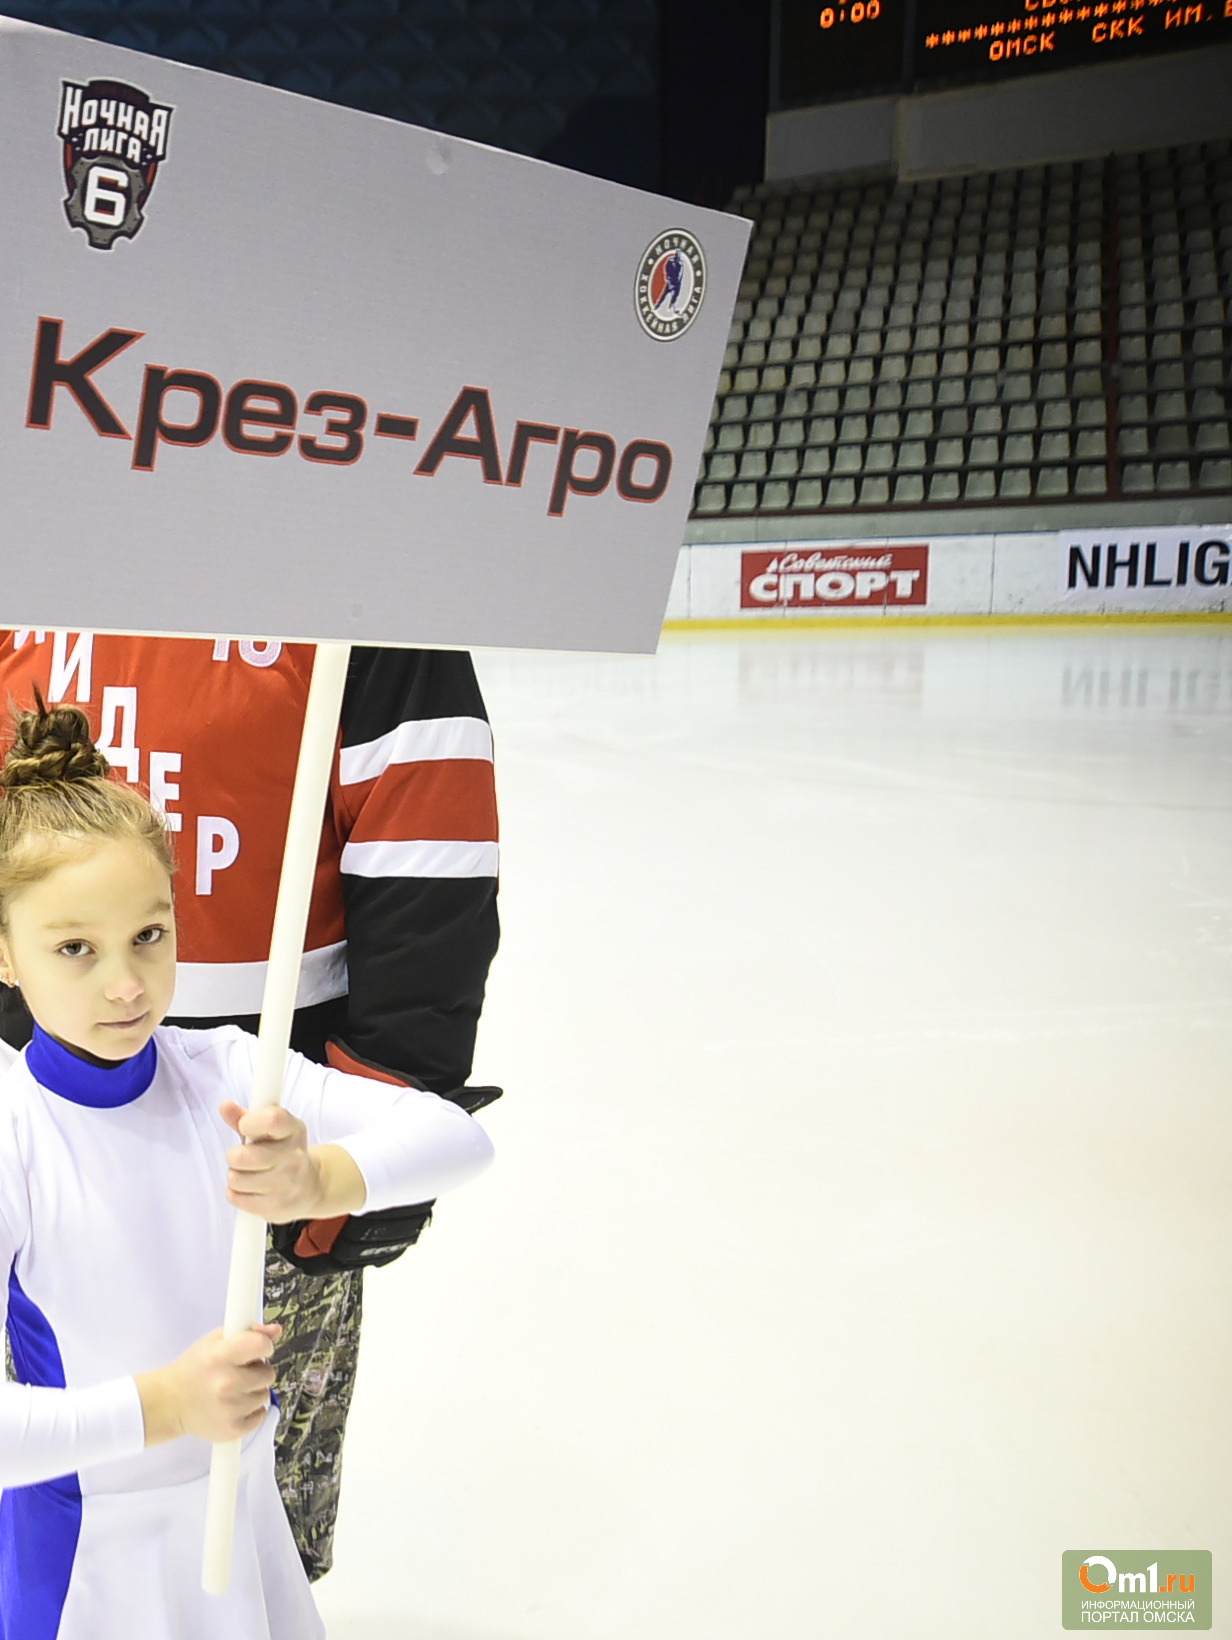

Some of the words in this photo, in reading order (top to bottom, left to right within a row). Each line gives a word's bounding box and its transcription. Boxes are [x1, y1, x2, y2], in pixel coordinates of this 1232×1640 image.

[819, 0, 880, 29] 0:00
[989, 31, 1055, 61] ОМСК
[1092, 15, 1144, 43] СКК
[83, 128, 142, 163] ЛИГА
[84, 165, 129, 227] 6
[25, 315, 674, 517] Крез-Агро
[749, 570, 921, 601] СПОРТ
[1067, 539, 1232, 589] NHLIG
[13, 630, 240, 895] ИДЕР
